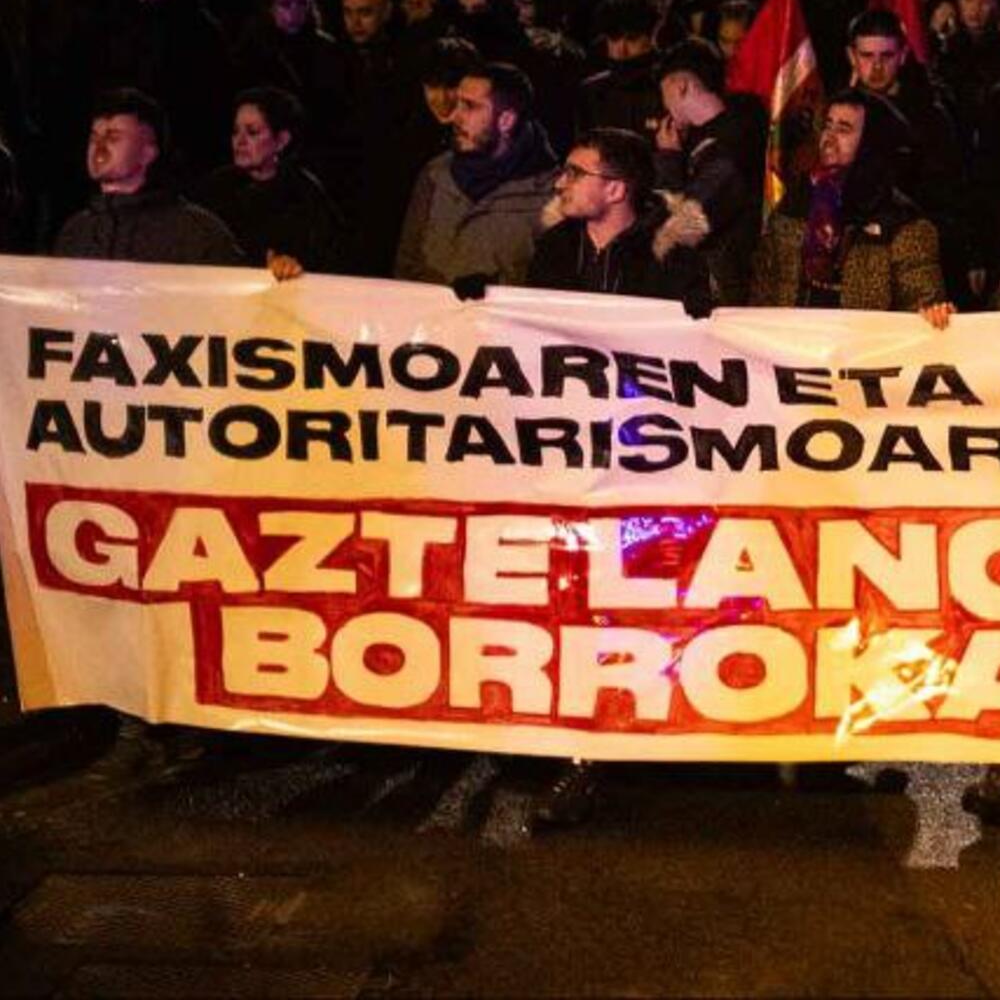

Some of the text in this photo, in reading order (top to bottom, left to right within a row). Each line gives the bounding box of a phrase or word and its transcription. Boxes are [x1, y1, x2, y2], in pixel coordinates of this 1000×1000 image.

[26, 327, 749, 406] FAXISMOAREN
[776, 365, 983, 408] ETA
[44, 499, 556, 607] GAZTE
